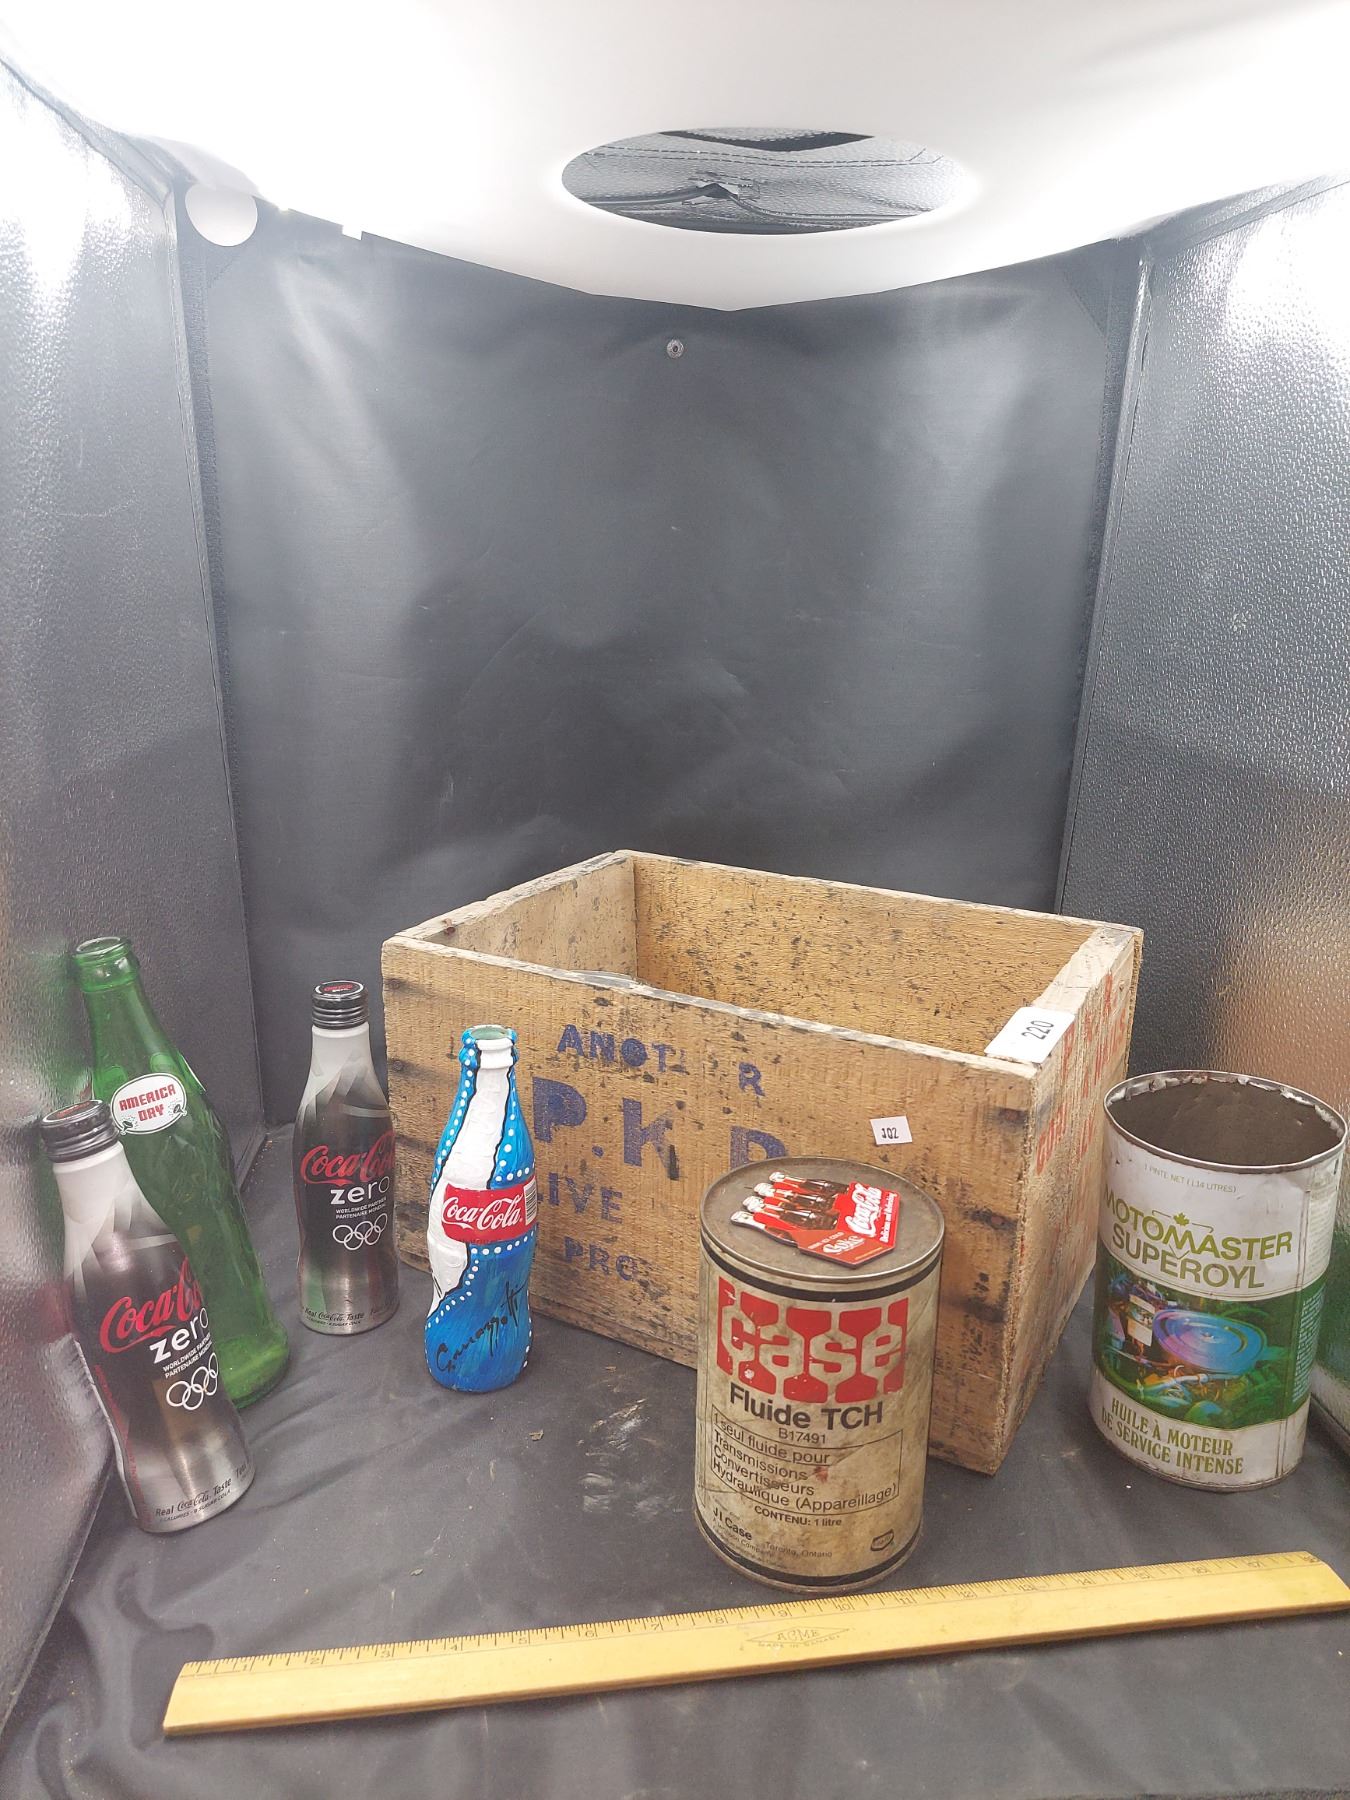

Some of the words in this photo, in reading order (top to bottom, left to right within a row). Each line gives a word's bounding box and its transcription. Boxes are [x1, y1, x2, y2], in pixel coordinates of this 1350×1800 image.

[1021, 1020, 1055, 1040] 220
[118, 1083, 176, 1111] AMERICA
[138, 1104, 165, 1121] DAY
[881, 1127, 900, 1140] 102
[330, 1176, 390, 1205] zero
[442, 1194, 523, 1232] Coca-Cola
[1104, 1184, 1292, 1261] MOTOMASTER
[823, 1235, 865, 1253] Coke
[1112, 1223, 1265, 1289] SUPEROYL
[149, 1307, 208, 1364] zero
[730, 1382, 811, 1429] Fluide
[821, 1402, 883, 1430] TCH
[720, 1420, 744, 1443] seul
[748, 1436, 788, 1459] fluide
[792, 1451, 830, 1464] pour
[778, 1428, 826, 1444] B17491
[1102, 1406, 1113, 1430] DE
[1115, 1421, 1171, 1463] SERVICE
[1177, 1451, 1244, 1475] INTENSE
[1112, 1398, 1149, 1434] HUILE
[1152, 1419, 1161, 1440] À
[1167, 1428, 1233, 1456] MOTEUR
[713, 1445, 815, 1495] Convertisseurs
[714, 1429, 808, 1481] Transmissions
[155, 1505, 174, 1517] Real
[212, 1478, 232, 1496] Taste
[713, 1457, 790, 1506] Hydraulique
[795, 1483, 896, 1513] (Appareillage)
[725, 1517, 753, 1541] Case
[754, 1505, 811, 1526] CONTENU:
[822, 1518, 842, 1526] litre
